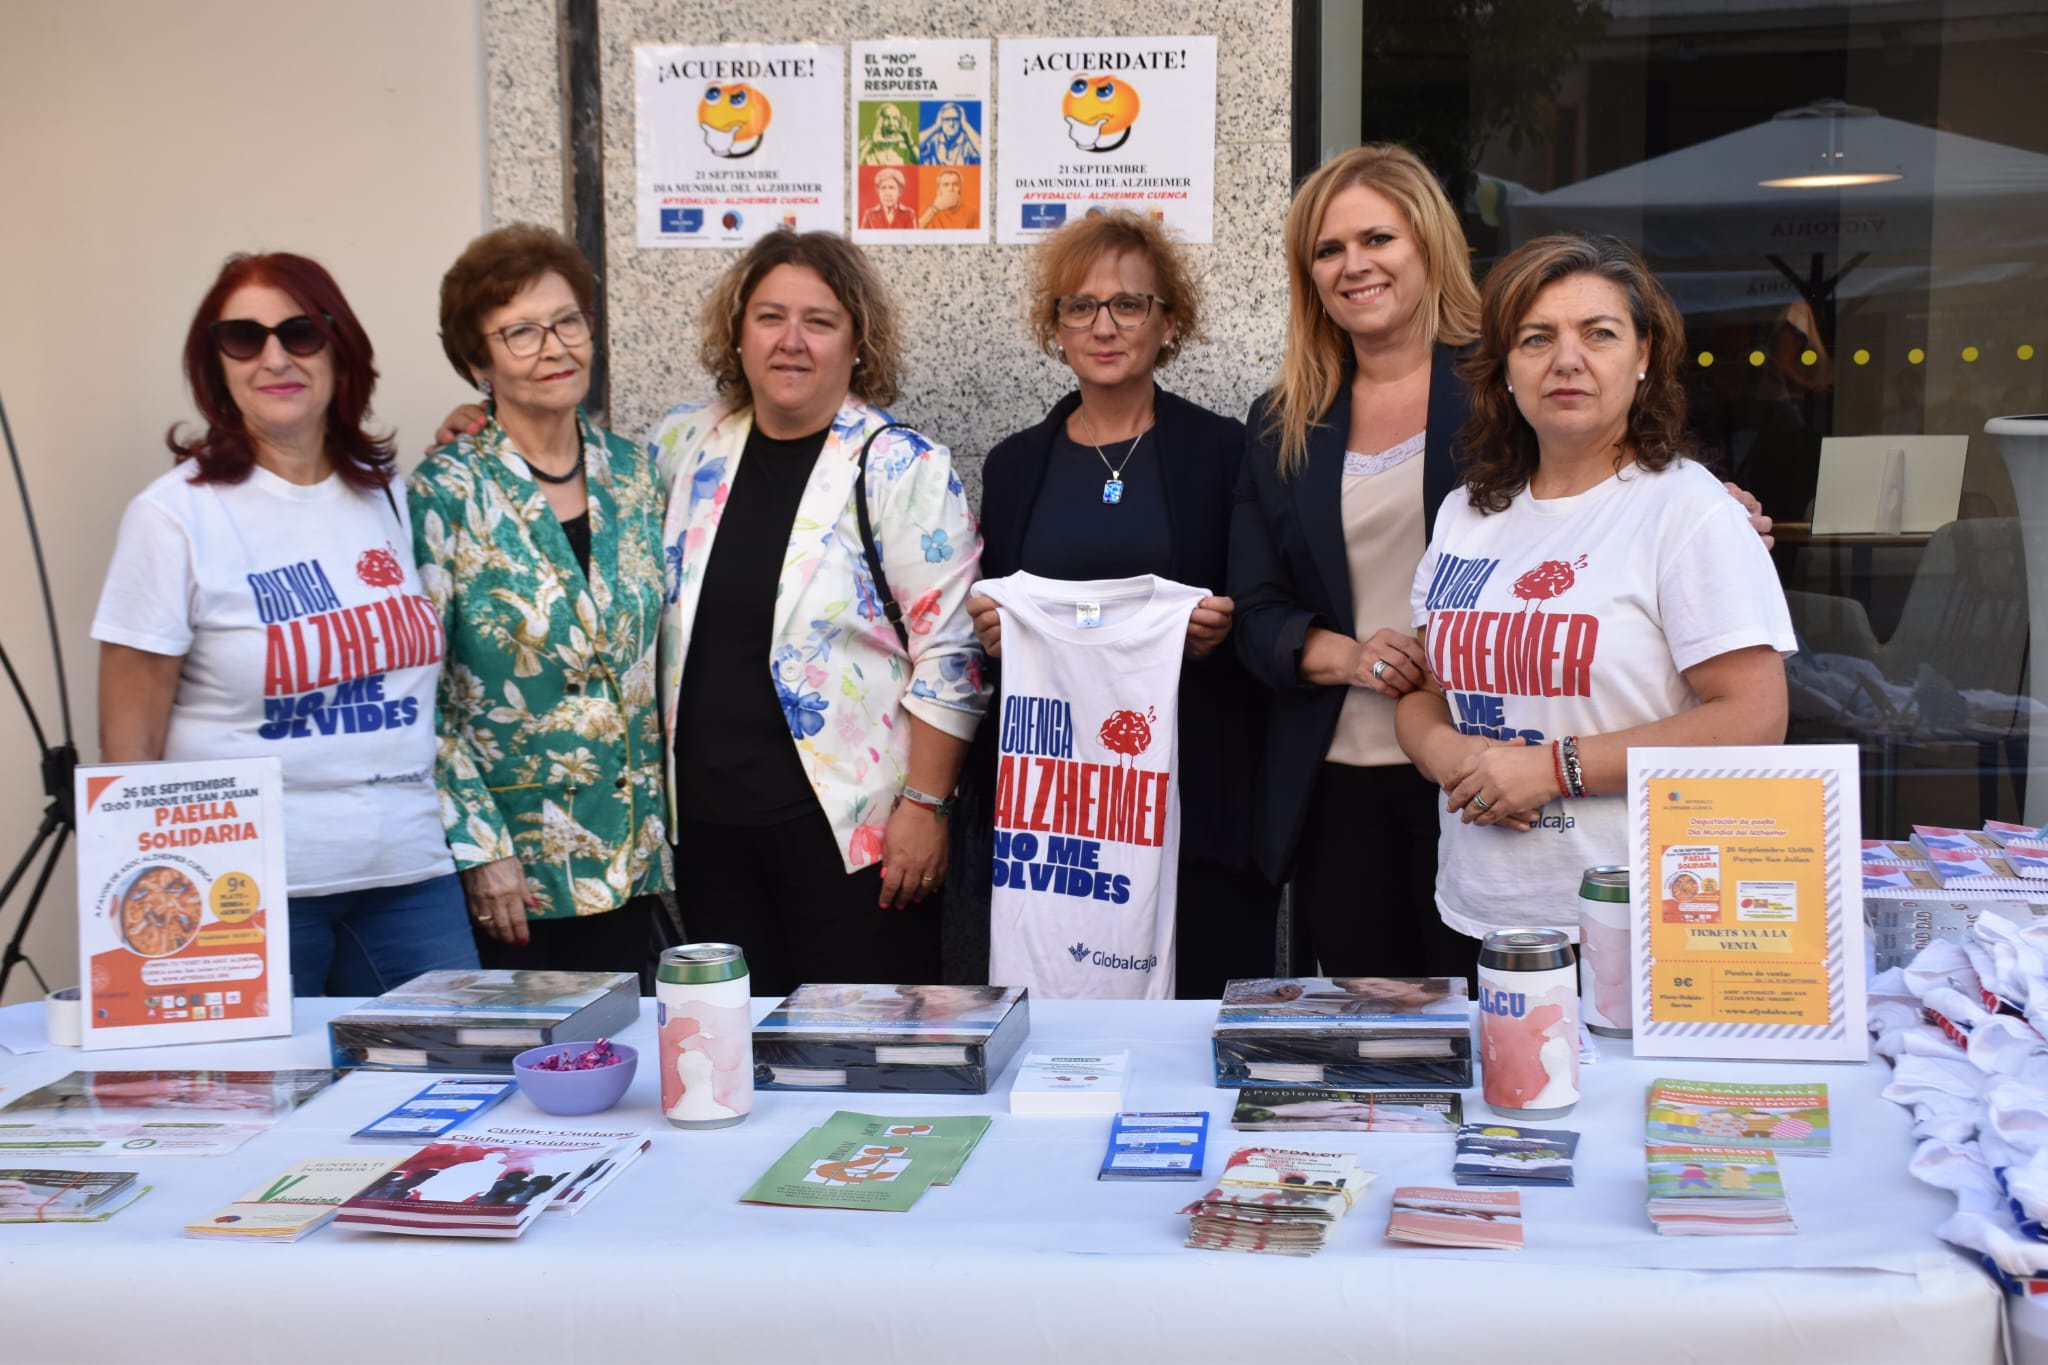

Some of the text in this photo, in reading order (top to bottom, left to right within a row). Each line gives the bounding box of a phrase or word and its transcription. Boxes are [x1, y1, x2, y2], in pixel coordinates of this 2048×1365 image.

[864, 54, 878, 64] EL
[1023, 50, 1186, 76] ¡ACUERDATE!
[658, 58, 815, 83] ¡ACUERDATE!
[864, 67, 923, 78] YA NO ES
[864, 80, 938, 90] RESPUESTA
[1058, 164, 1147, 174] 21 SEPTIEMBRE
[695, 170, 779, 180] 21 SEPTIEMBRE
[676, 184, 726, 192] MUNDIAL
[730, 184, 750, 192] DEL
[756, 183, 822, 192] ALZHEIMER
[1016, 178, 1191, 188] DIA MUNDIAL DEL ALZHEIMER
[1088, 192, 1144, 200] ALZHEIMER
[1147, 191, 1188, 199] CUENCA
[247, 559, 342, 625] CUENCA
[332, 674, 385, 706] ME
[1454, 692, 1505, 727] ME
[1001, 695, 1073, 759] CUENCA
[122, 777, 236, 798] 26 DE SEPTIEMBRE
[136, 796, 176, 808] PARQUE
[178, 794, 195, 804] DE
[197, 792, 218, 802] SAN
[221, 788, 258, 800] JULIAN
[155, 800, 238, 828] PAELLA
[138, 822, 258, 852] SOLIDARIA
[993, 830, 1100, 870] NO ME
[992, 856, 1131, 905] OLVIDES
[1690, 928, 1788, 938] TICKETS YA A LA
[1720, 941, 1758, 950] VENTA
[1092, 951, 1158, 974] Globalcaja
[1674, 978, 1693, 987] 9€
[1664, 1084, 1708, 1092] VIDA
[452, 1134, 510, 1144] Cuidar
[1248, 1148, 1342, 1158] AFYEDALCU
